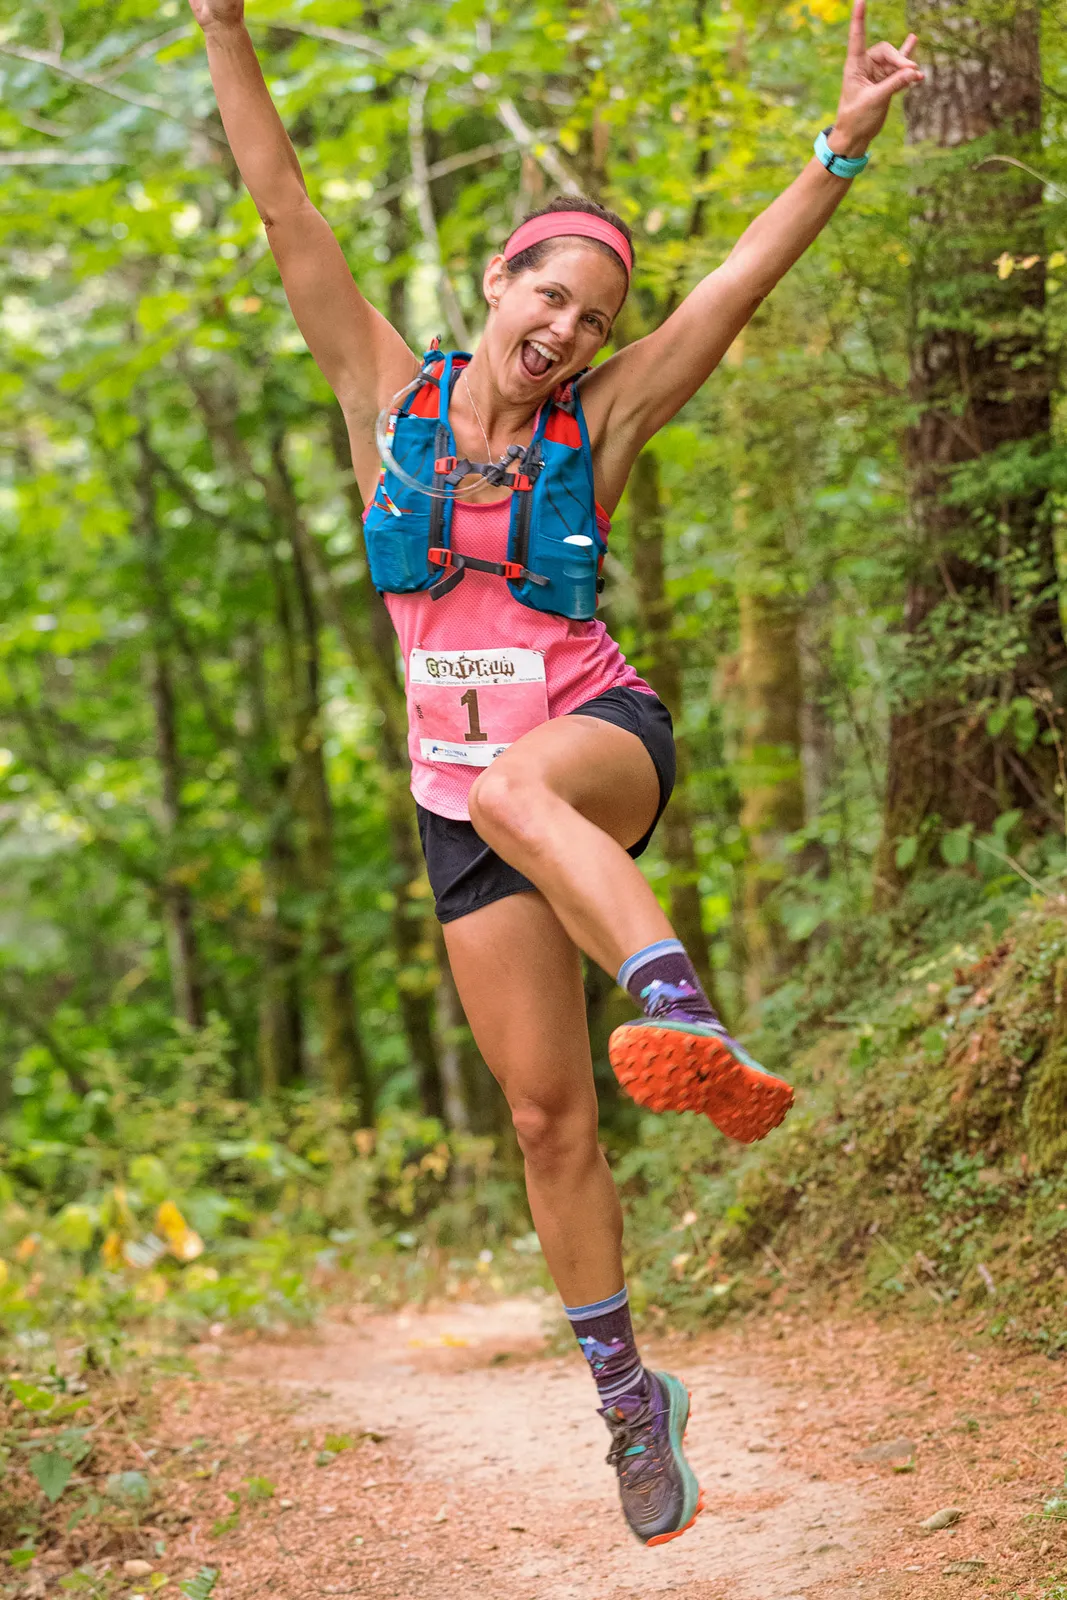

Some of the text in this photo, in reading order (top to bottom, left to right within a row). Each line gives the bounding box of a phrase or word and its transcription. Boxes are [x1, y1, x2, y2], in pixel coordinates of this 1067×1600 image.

[426, 658, 515, 678] GOAT RUN
[460, 688, 488, 742] 1
